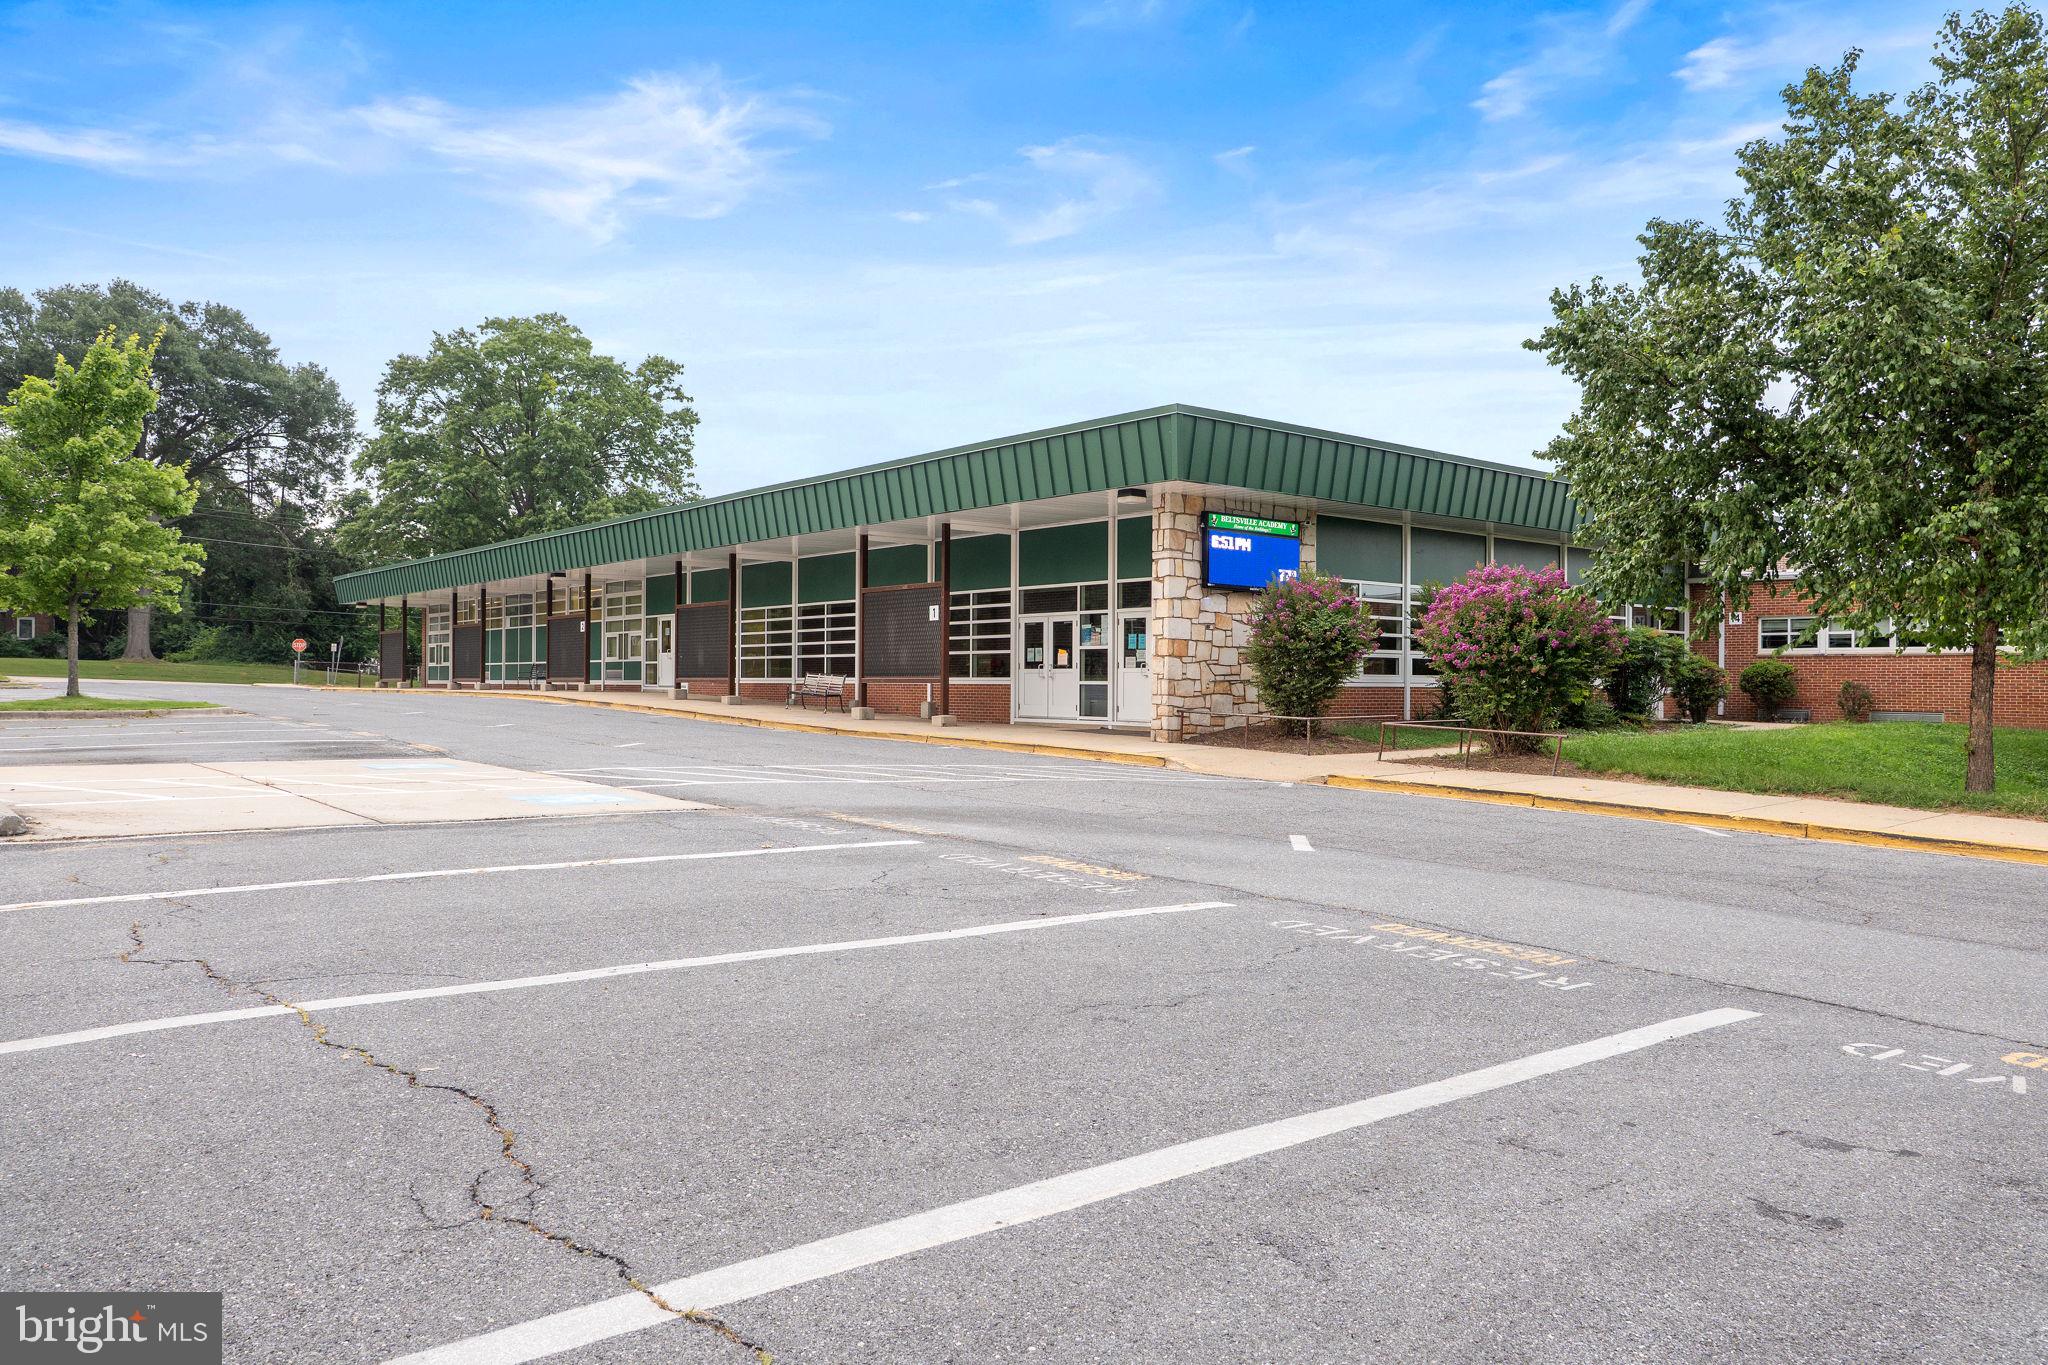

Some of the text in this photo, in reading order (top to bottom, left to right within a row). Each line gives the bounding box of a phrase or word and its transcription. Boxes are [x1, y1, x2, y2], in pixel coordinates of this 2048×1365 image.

[1221, 515, 1287, 529] BELTSVILLE ACADEMY
[1234, 537, 1252, 551] PM
[939, 853, 1138, 894] RESERVED
[1270, 919, 1593, 991] RESERVED
